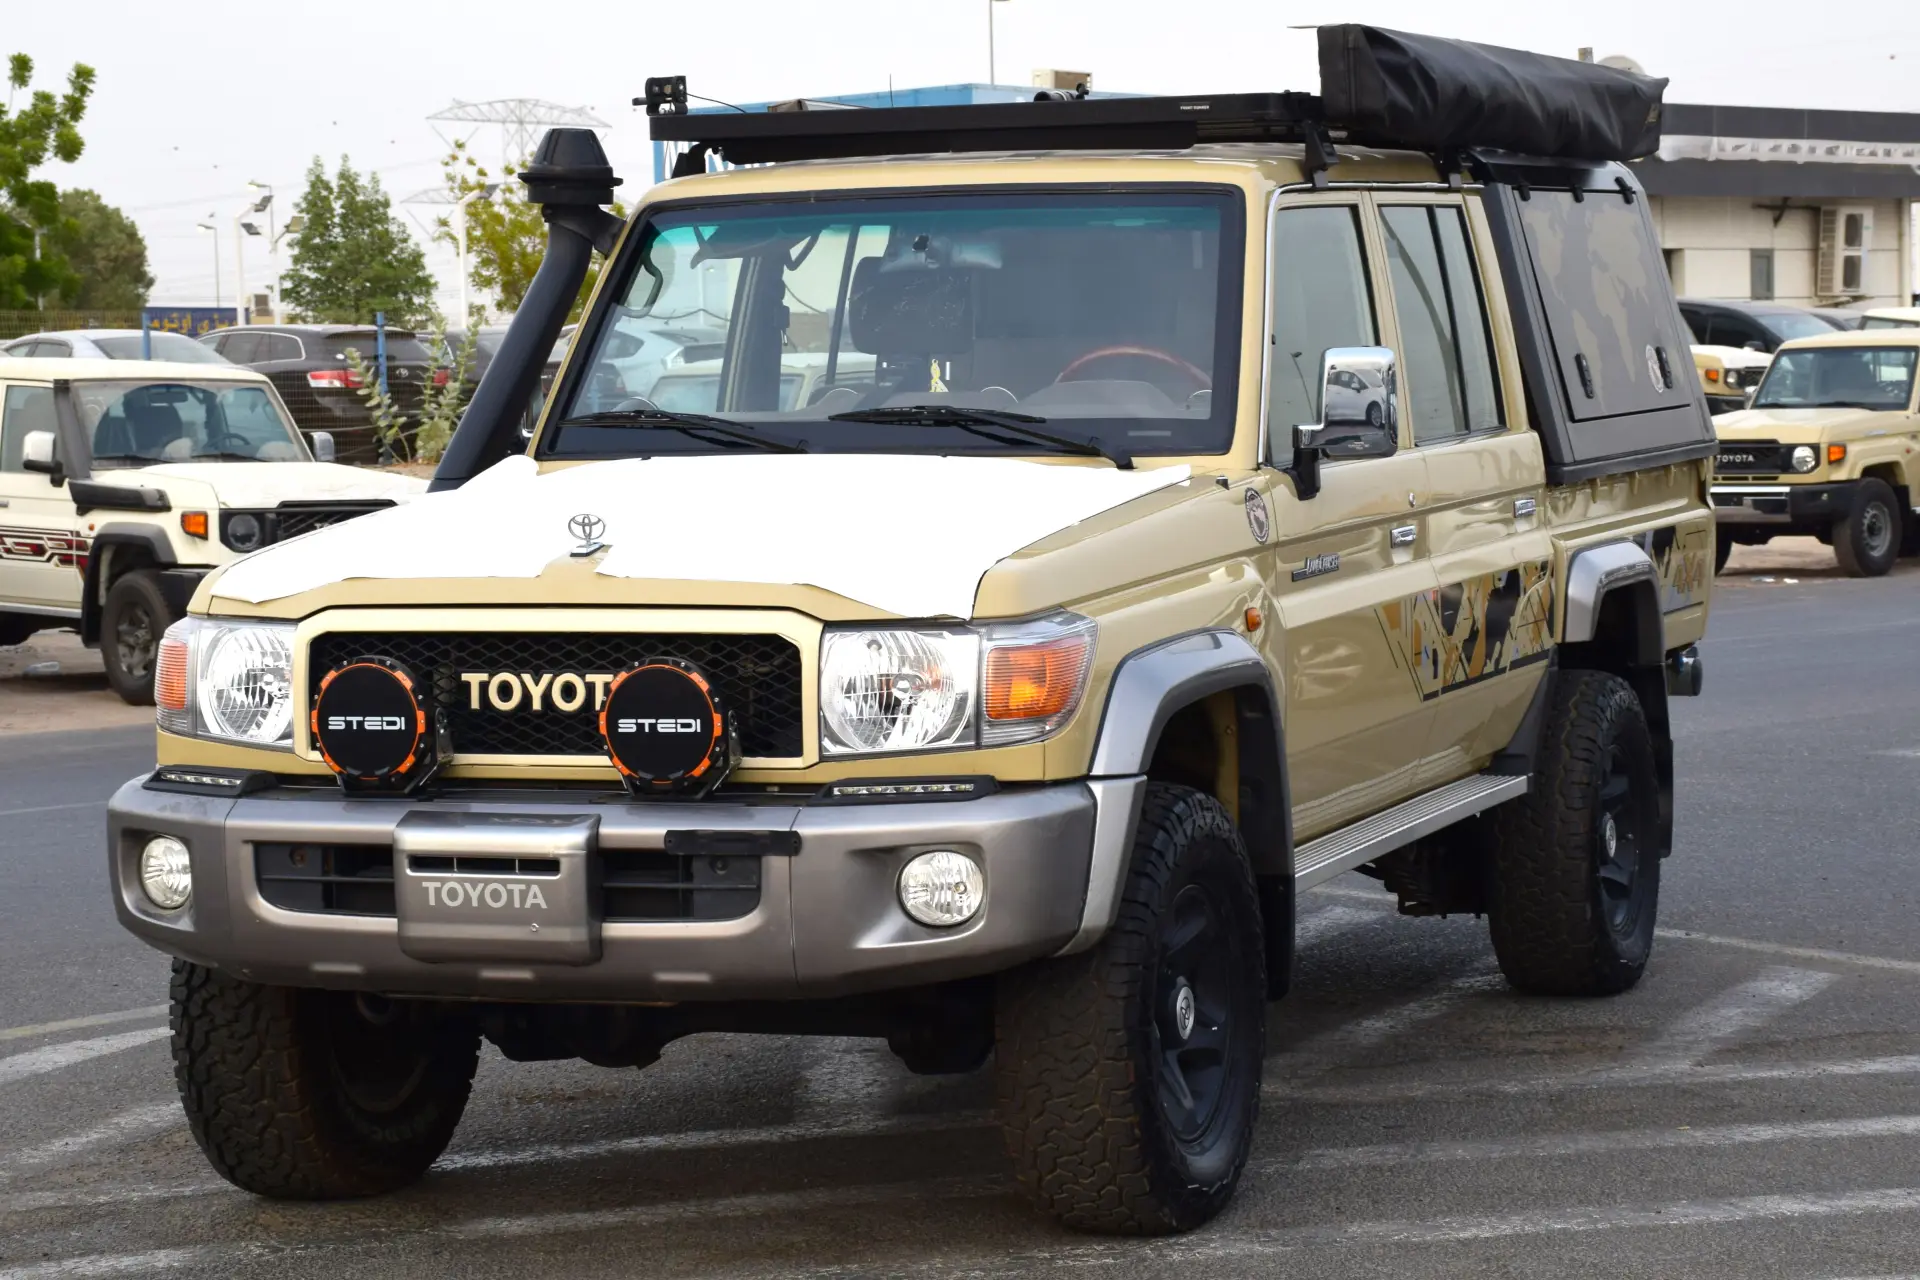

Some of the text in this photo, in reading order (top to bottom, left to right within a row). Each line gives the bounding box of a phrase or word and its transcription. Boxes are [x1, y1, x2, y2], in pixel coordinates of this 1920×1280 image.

[461, 672, 614, 712] TOYOT
[328, 716, 405, 730] STEDI
[618, 718, 701, 733] STEDI
[422, 881, 548, 909] TOYOTA
